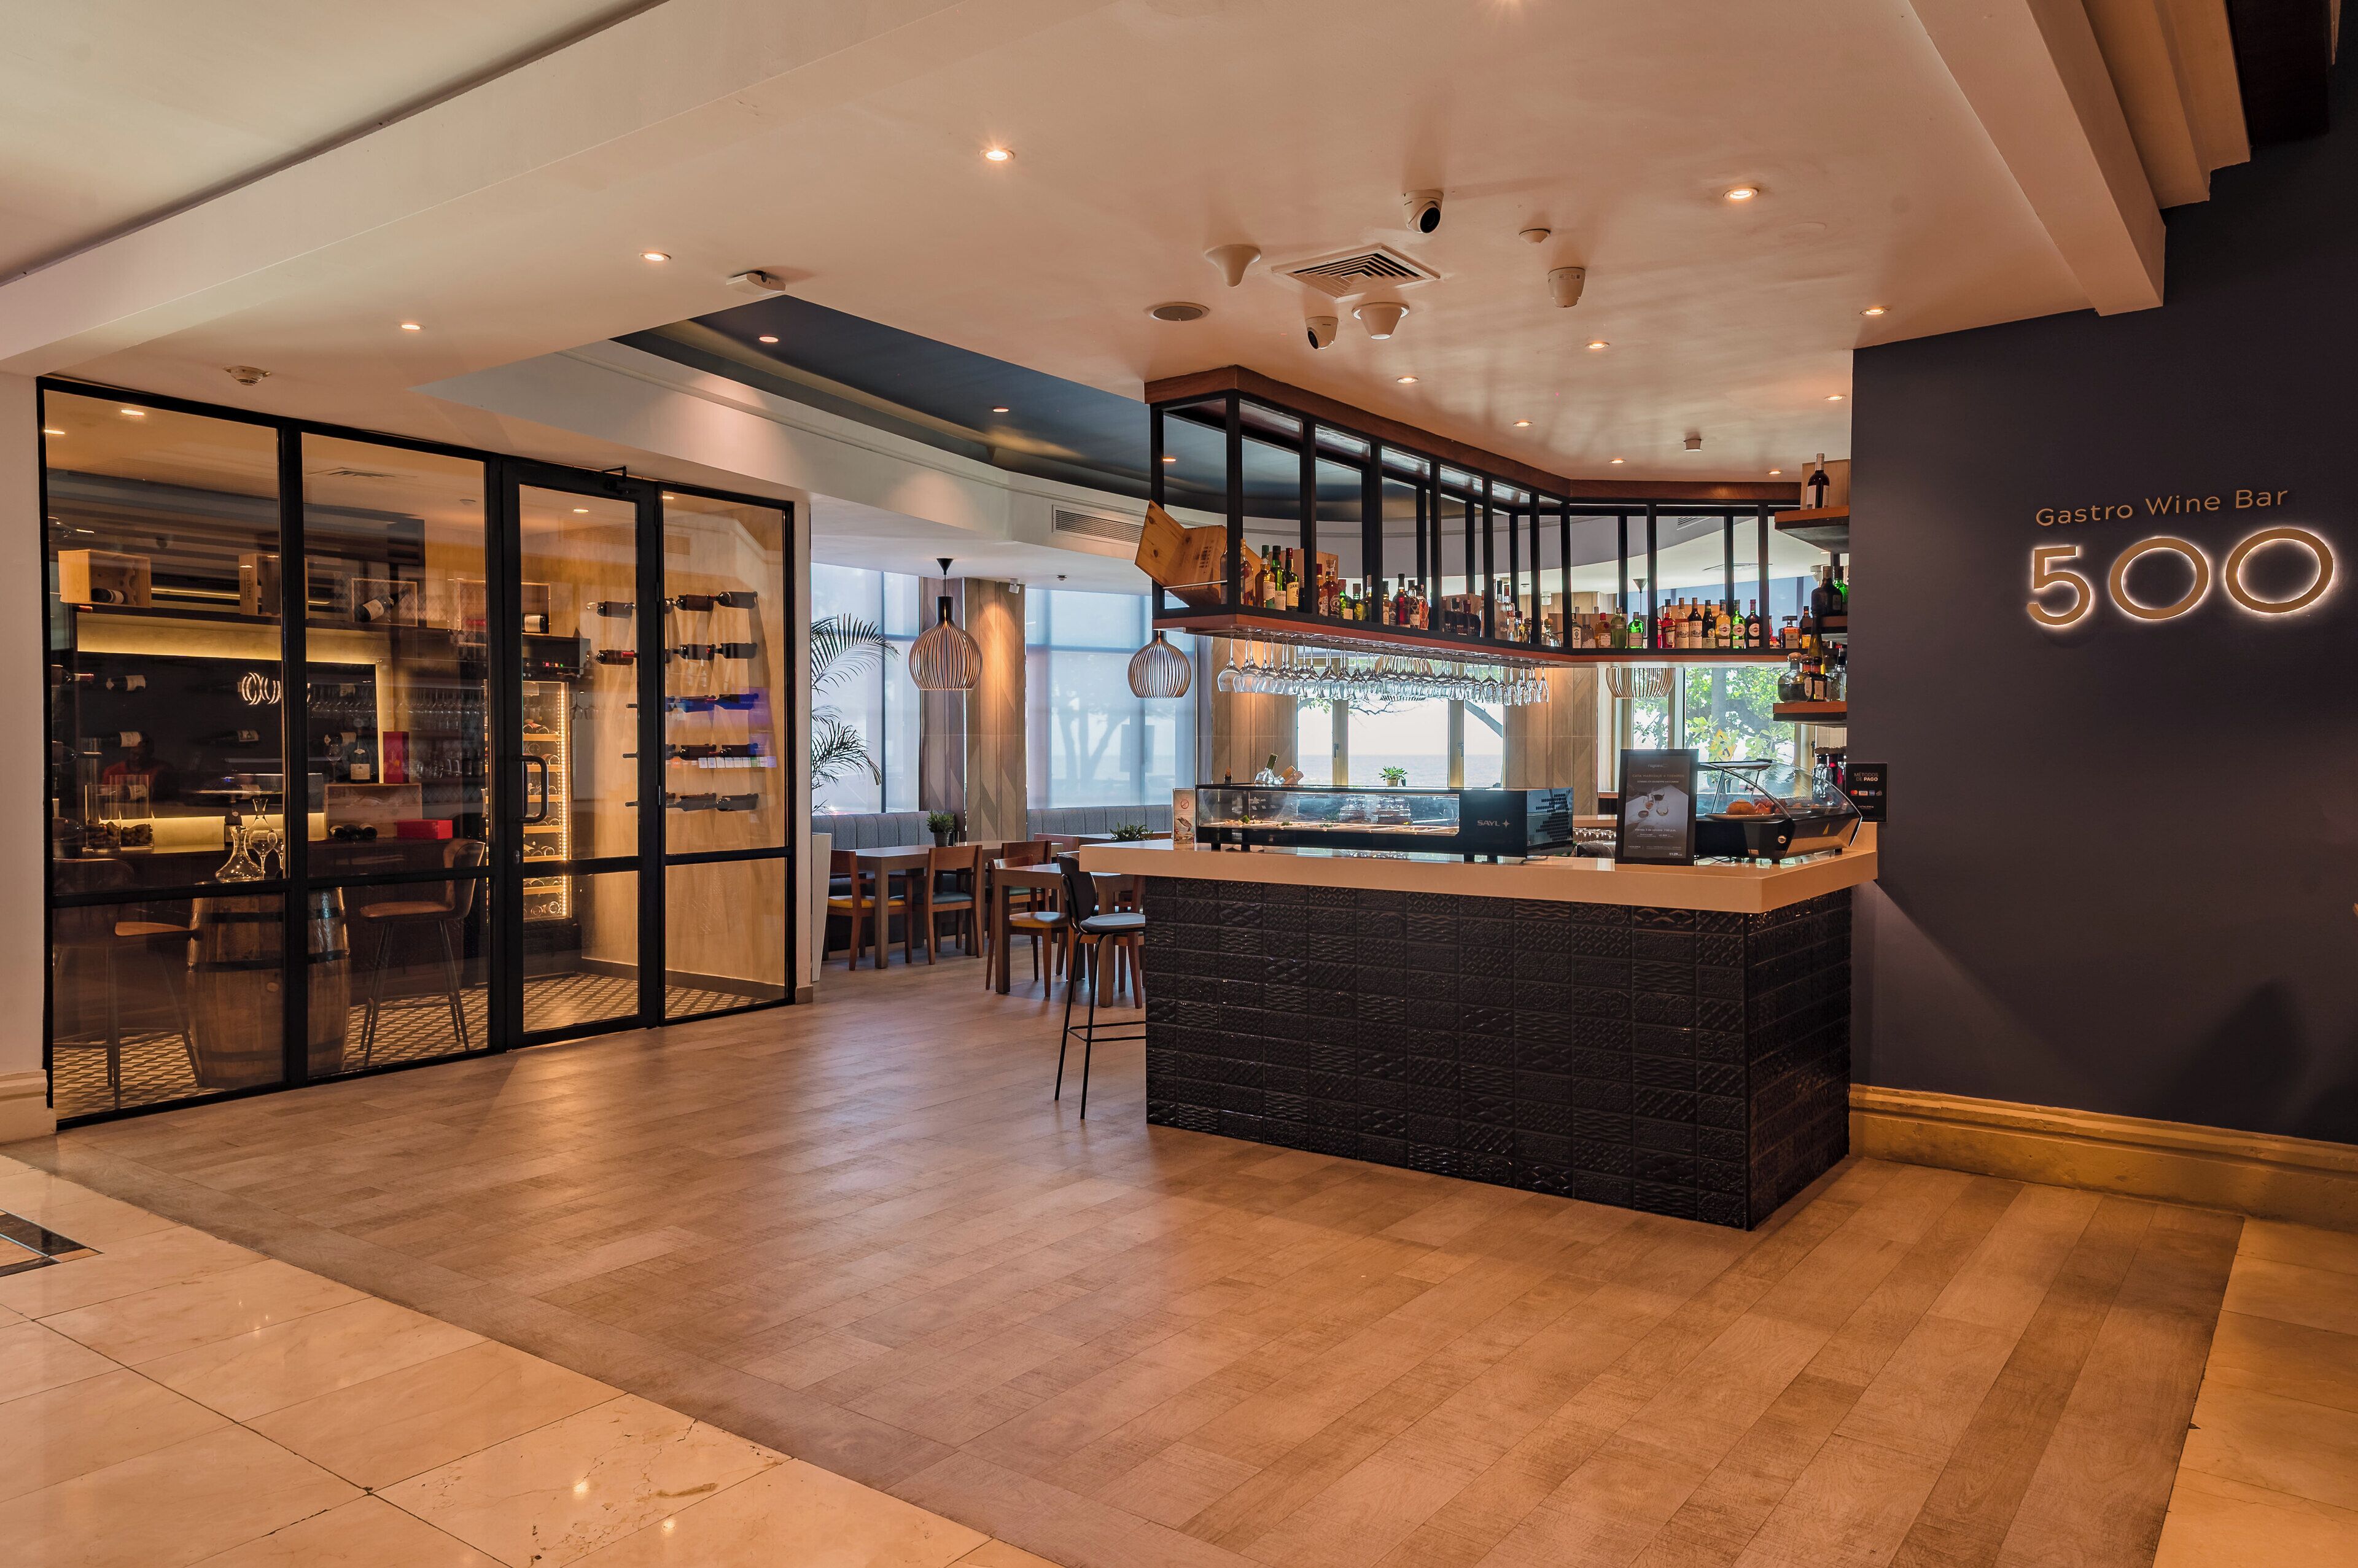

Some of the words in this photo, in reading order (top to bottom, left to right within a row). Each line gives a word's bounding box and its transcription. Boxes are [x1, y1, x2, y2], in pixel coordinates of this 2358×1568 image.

[2036, 503, 2133, 526] Gastro
[2146, 495, 2220, 516] Wine
[2236, 489, 2288, 508] Bar
[2026, 528, 2334, 626] 500
